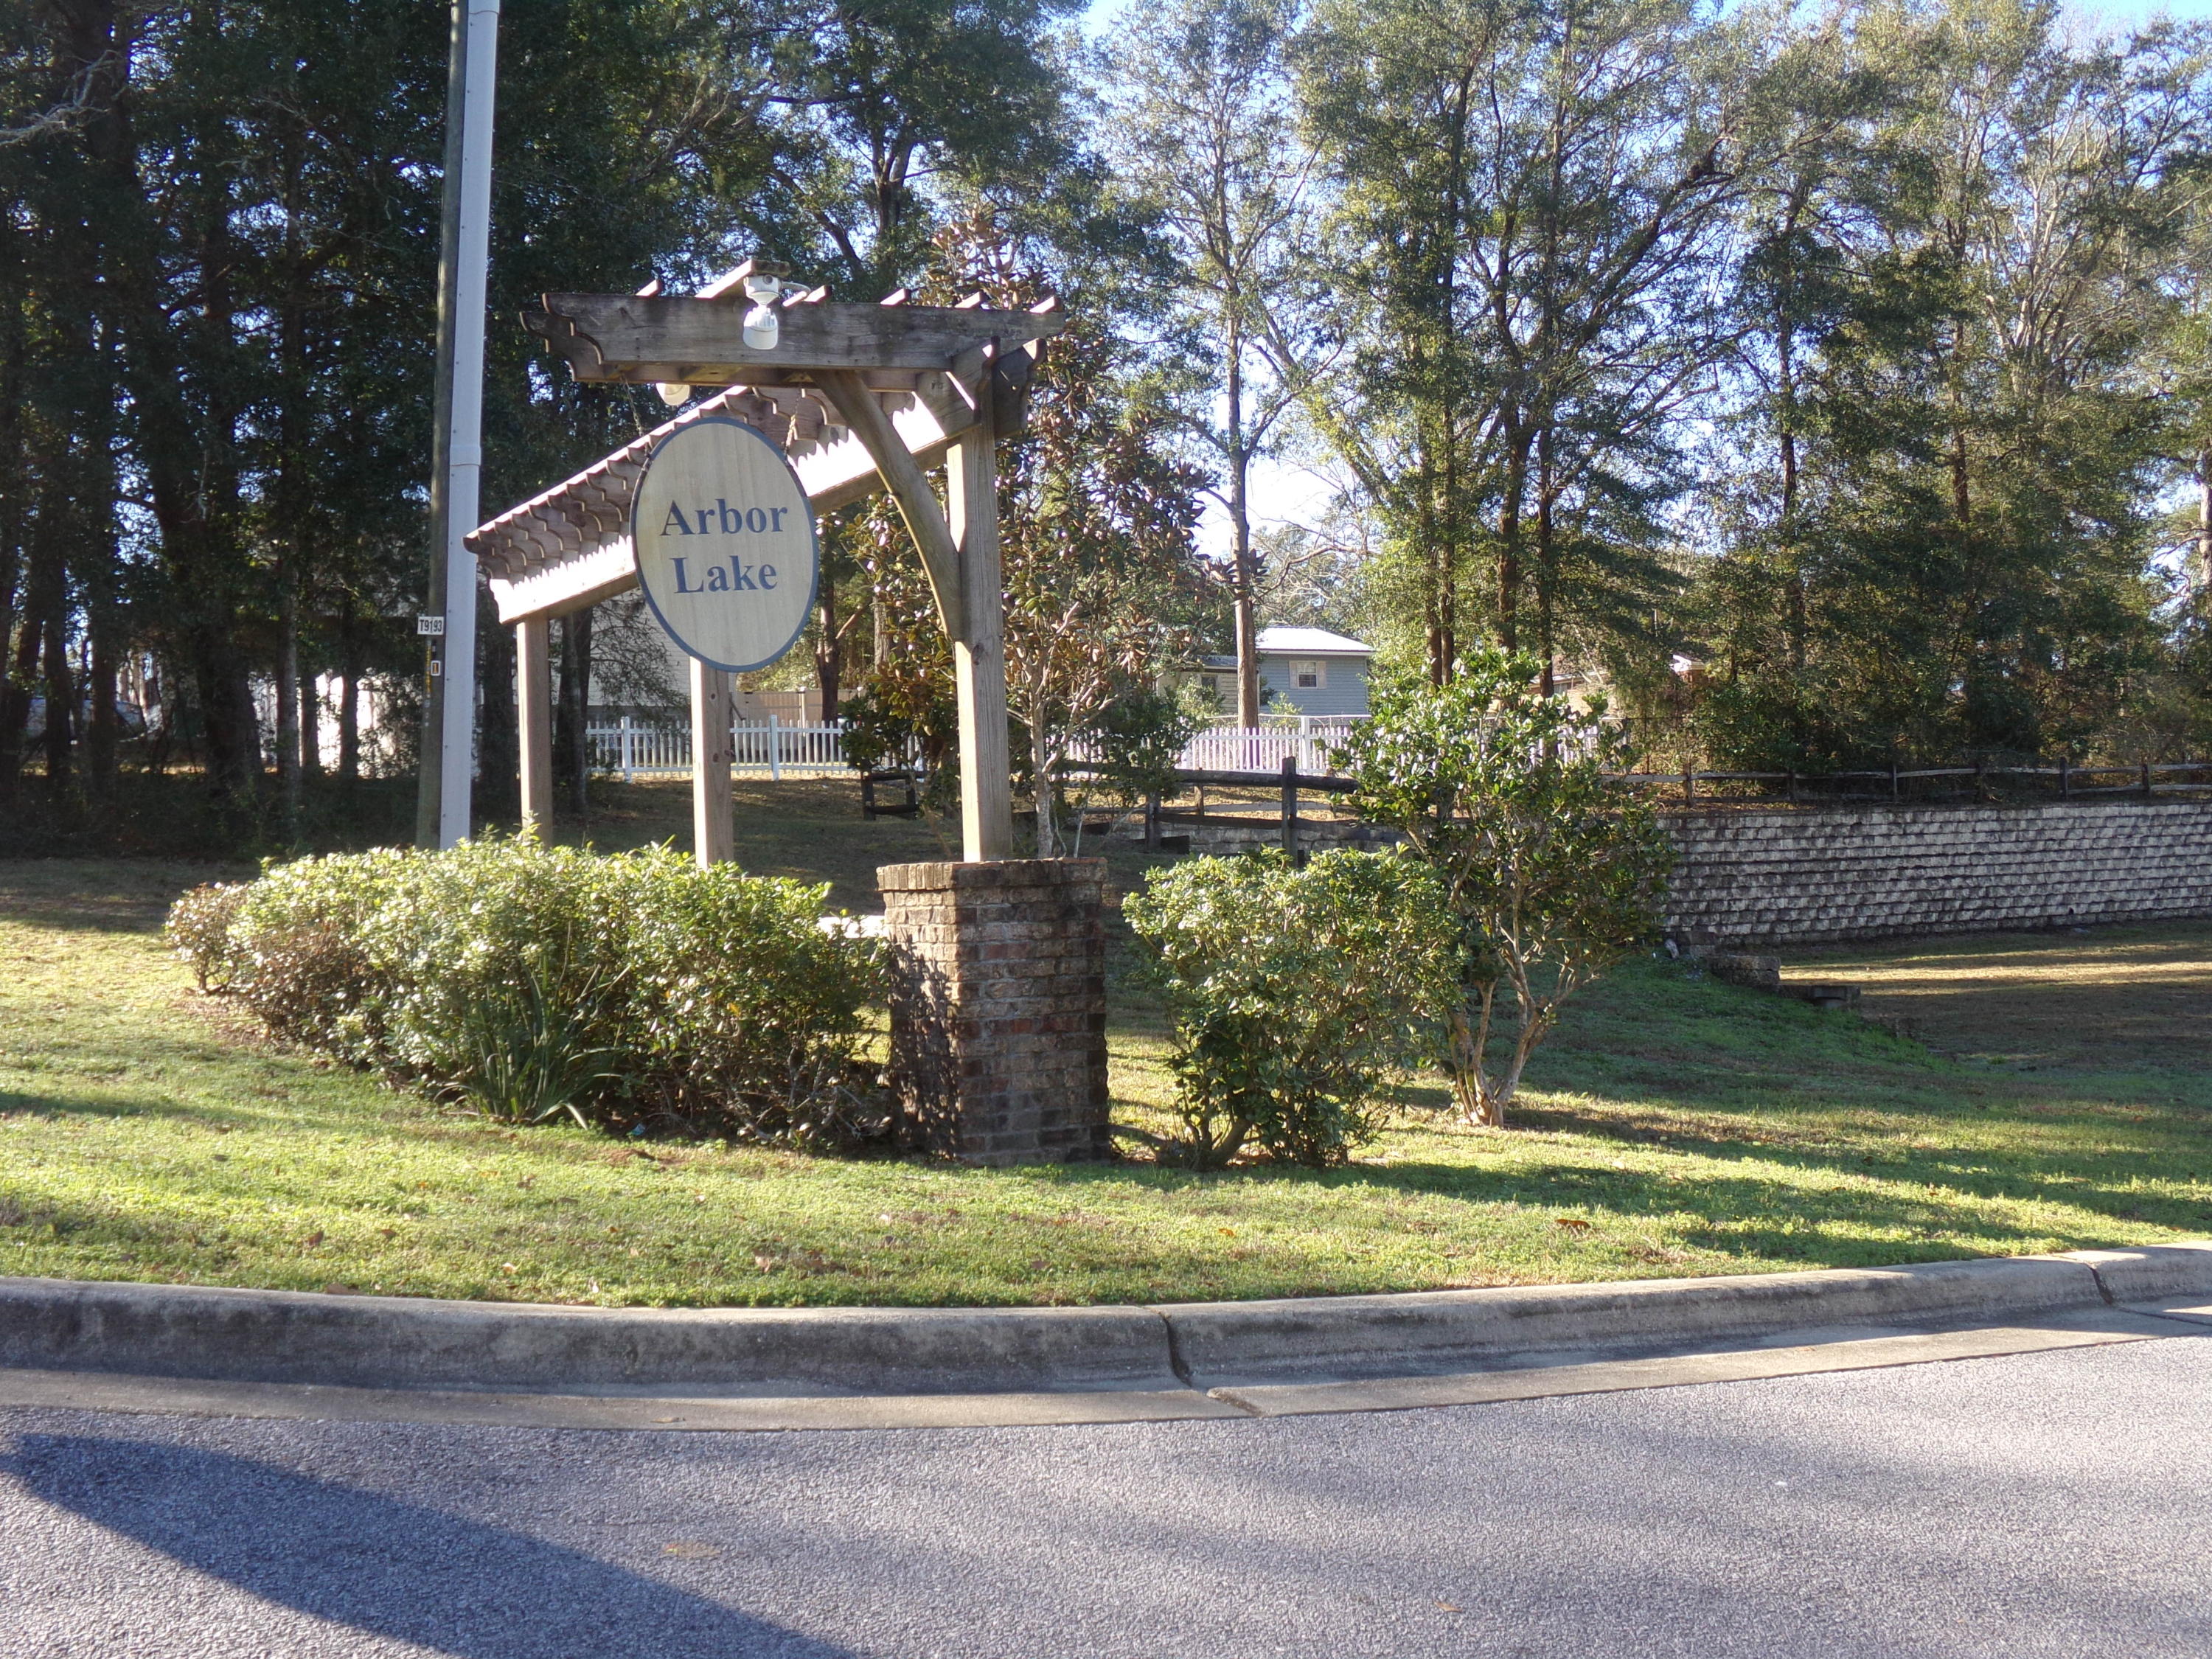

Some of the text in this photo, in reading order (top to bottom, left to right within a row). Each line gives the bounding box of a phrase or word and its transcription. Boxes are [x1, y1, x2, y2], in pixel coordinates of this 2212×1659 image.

[660, 498, 788, 536] Arbor
[669, 555, 778, 594] Lake
[420, 619, 442, 633] T9193
